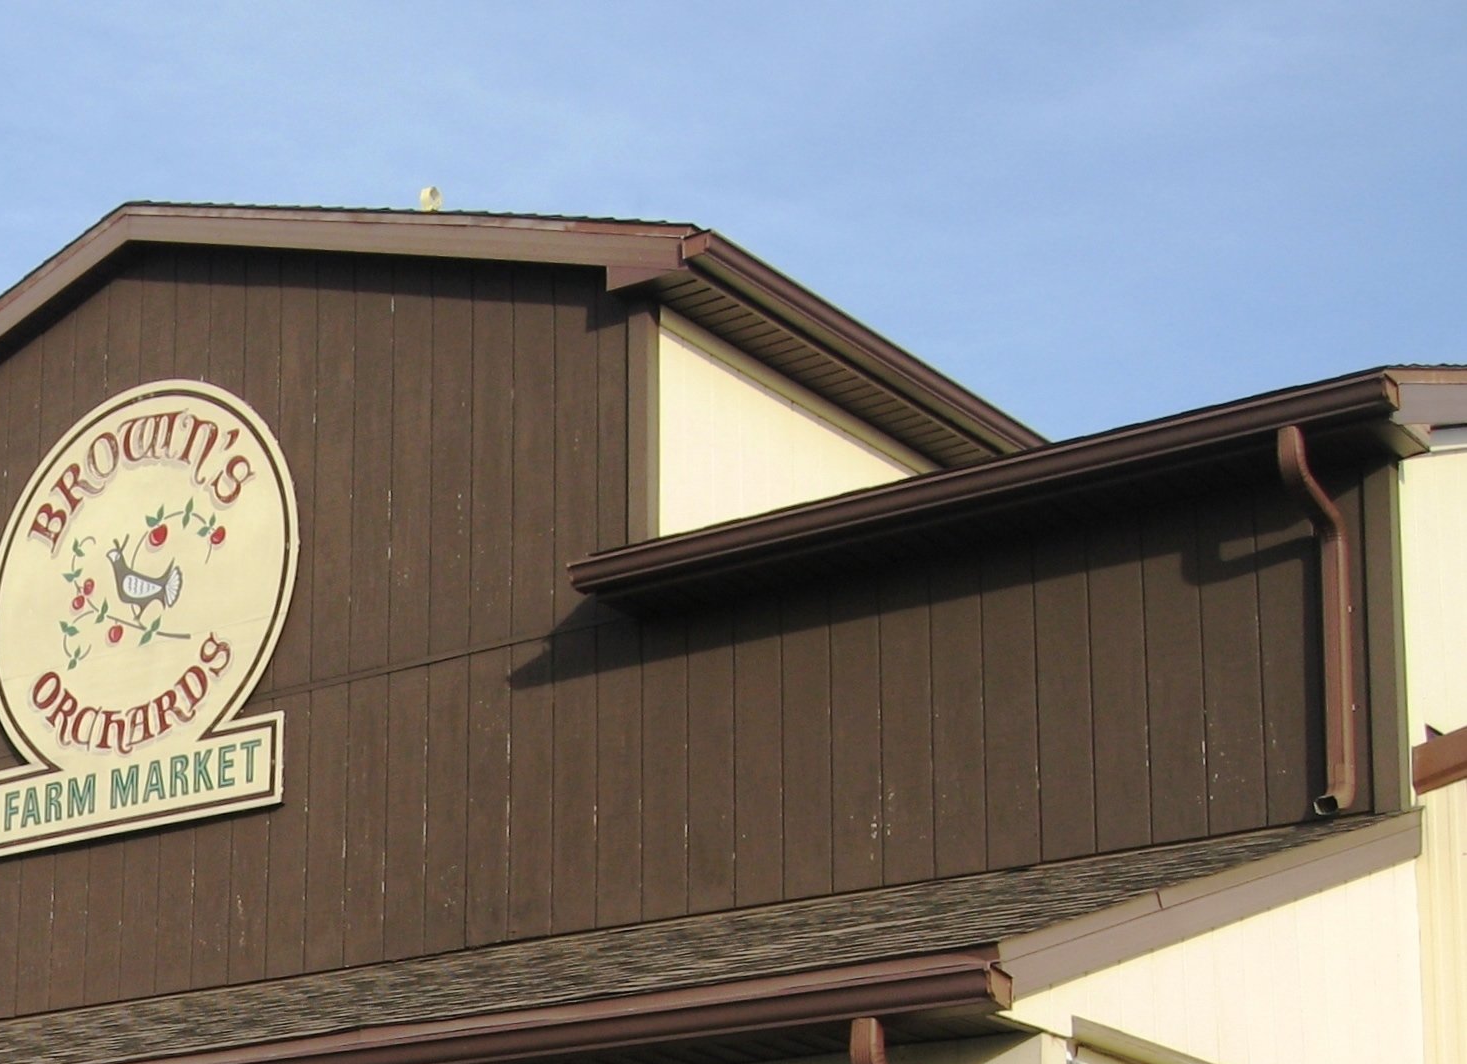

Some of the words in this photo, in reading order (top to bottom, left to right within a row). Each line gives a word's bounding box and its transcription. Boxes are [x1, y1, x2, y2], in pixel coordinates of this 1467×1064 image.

[27, 408, 256, 555] BROWN'S
[32, 631, 233, 754] ORCHARDS
[3, 773, 97, 832] FARM
[109, 738, 263, 812] MARKET
